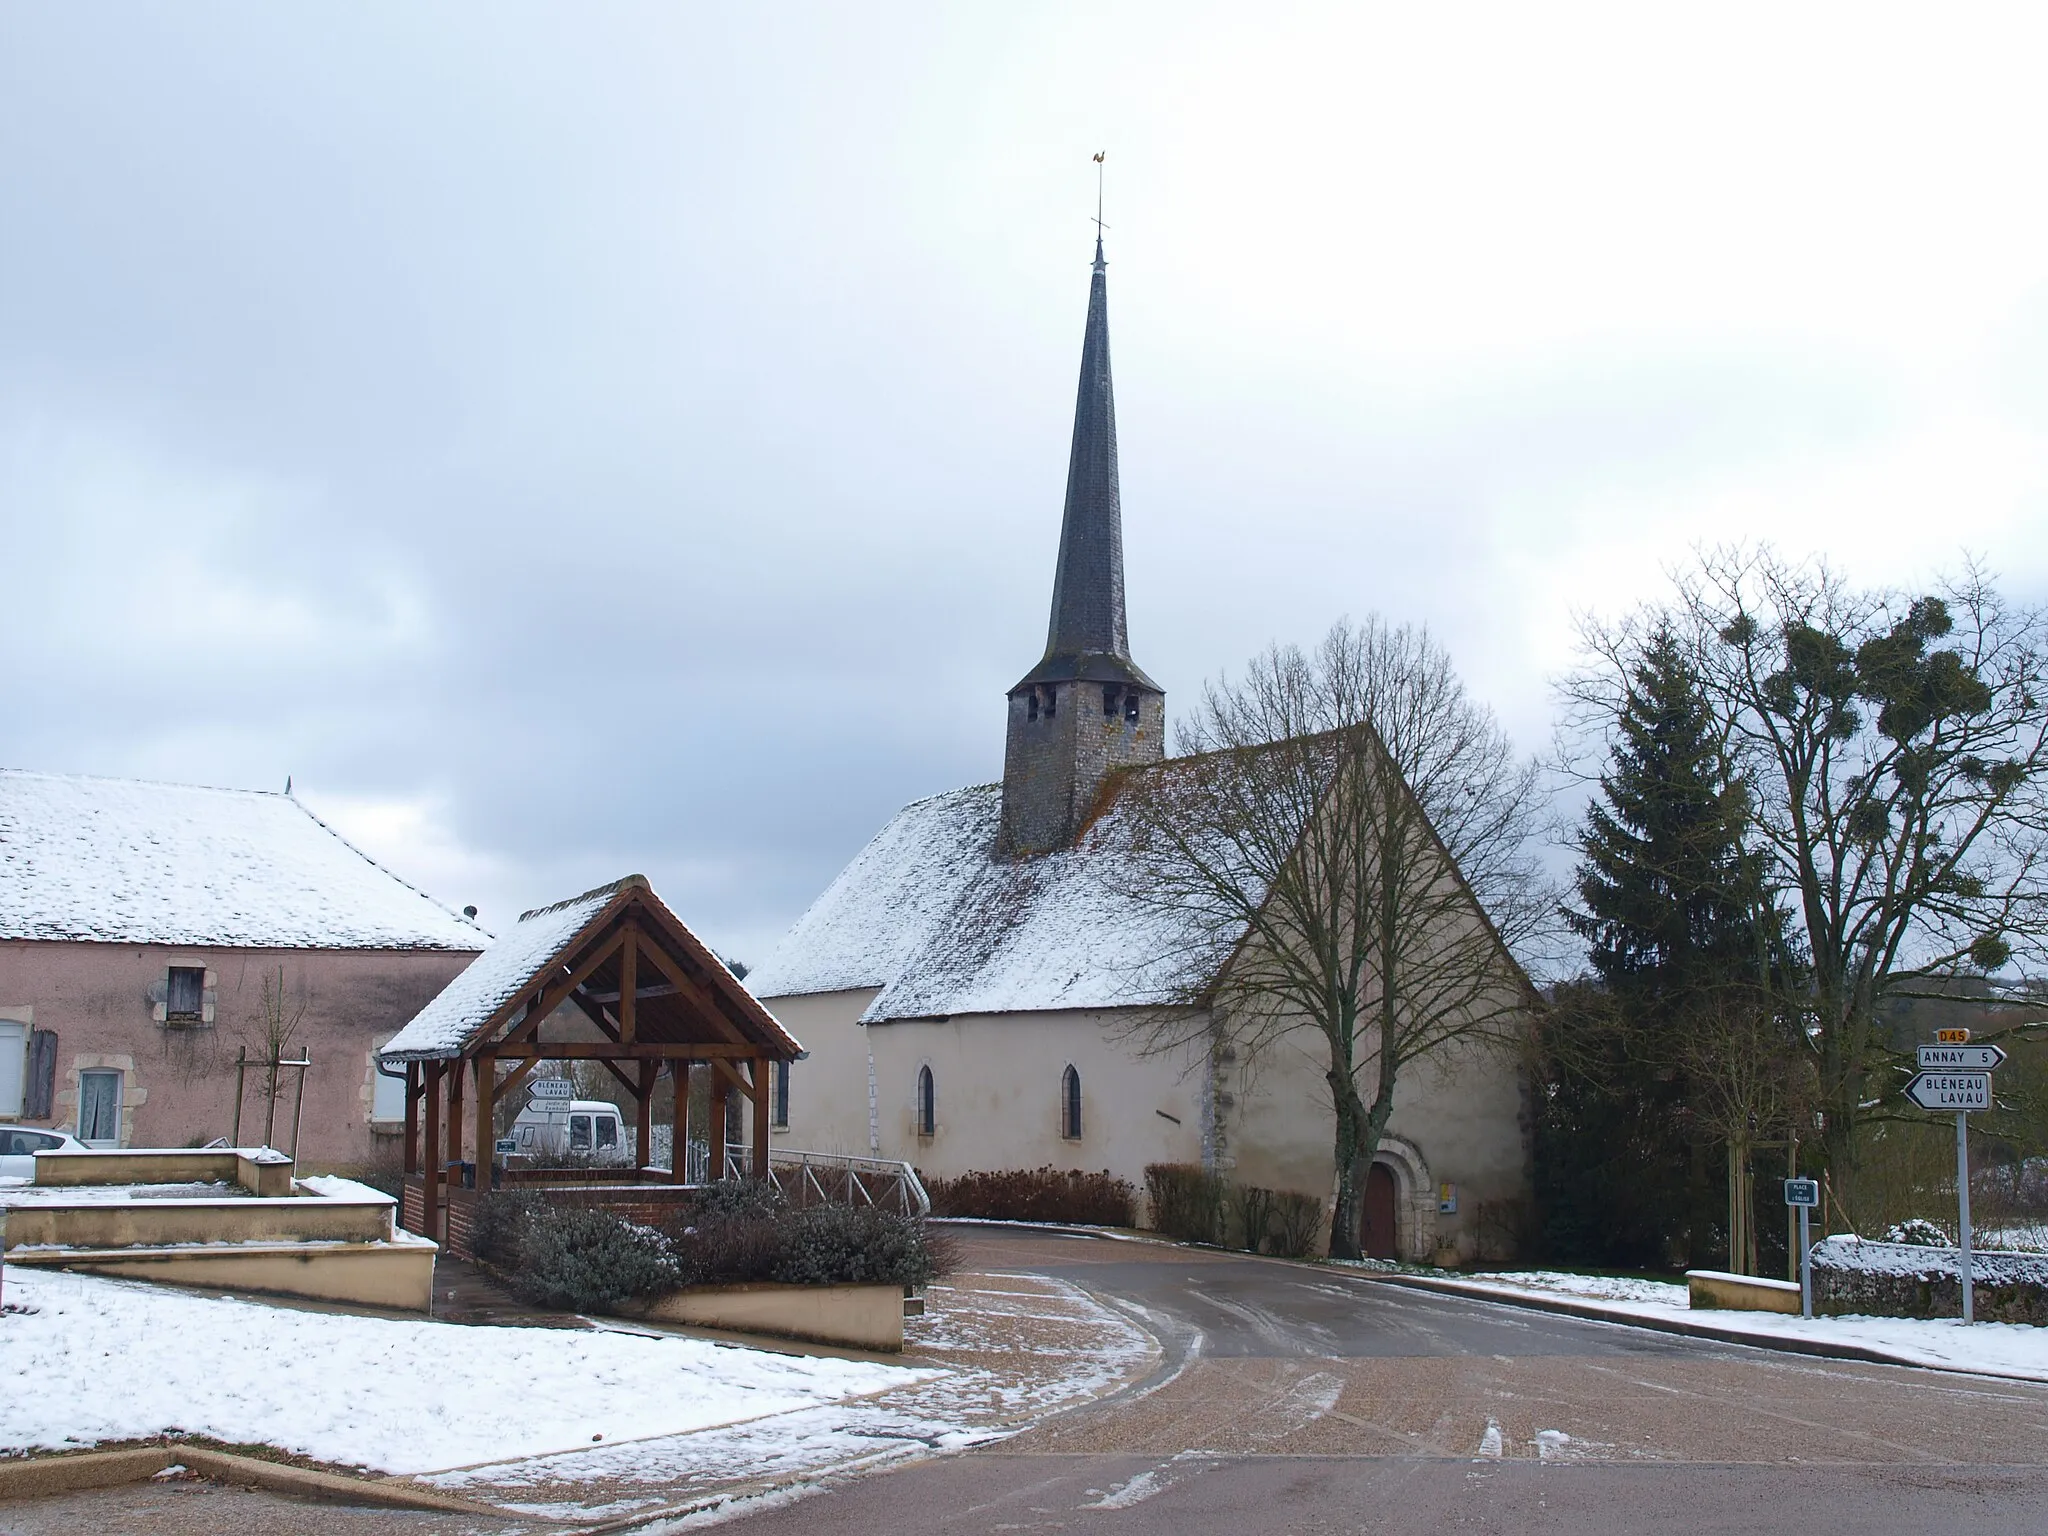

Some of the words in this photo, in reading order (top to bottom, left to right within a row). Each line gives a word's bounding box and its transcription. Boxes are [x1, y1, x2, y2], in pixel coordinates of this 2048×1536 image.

[1924, 1051, 1965, 1062] ANNAY
[1981, 1052, 1989, 1063] 5
[1926, 1076, 1982, 1089] BLÉNEAU
[1941, 1093, 1983, 1103] LAVAU
